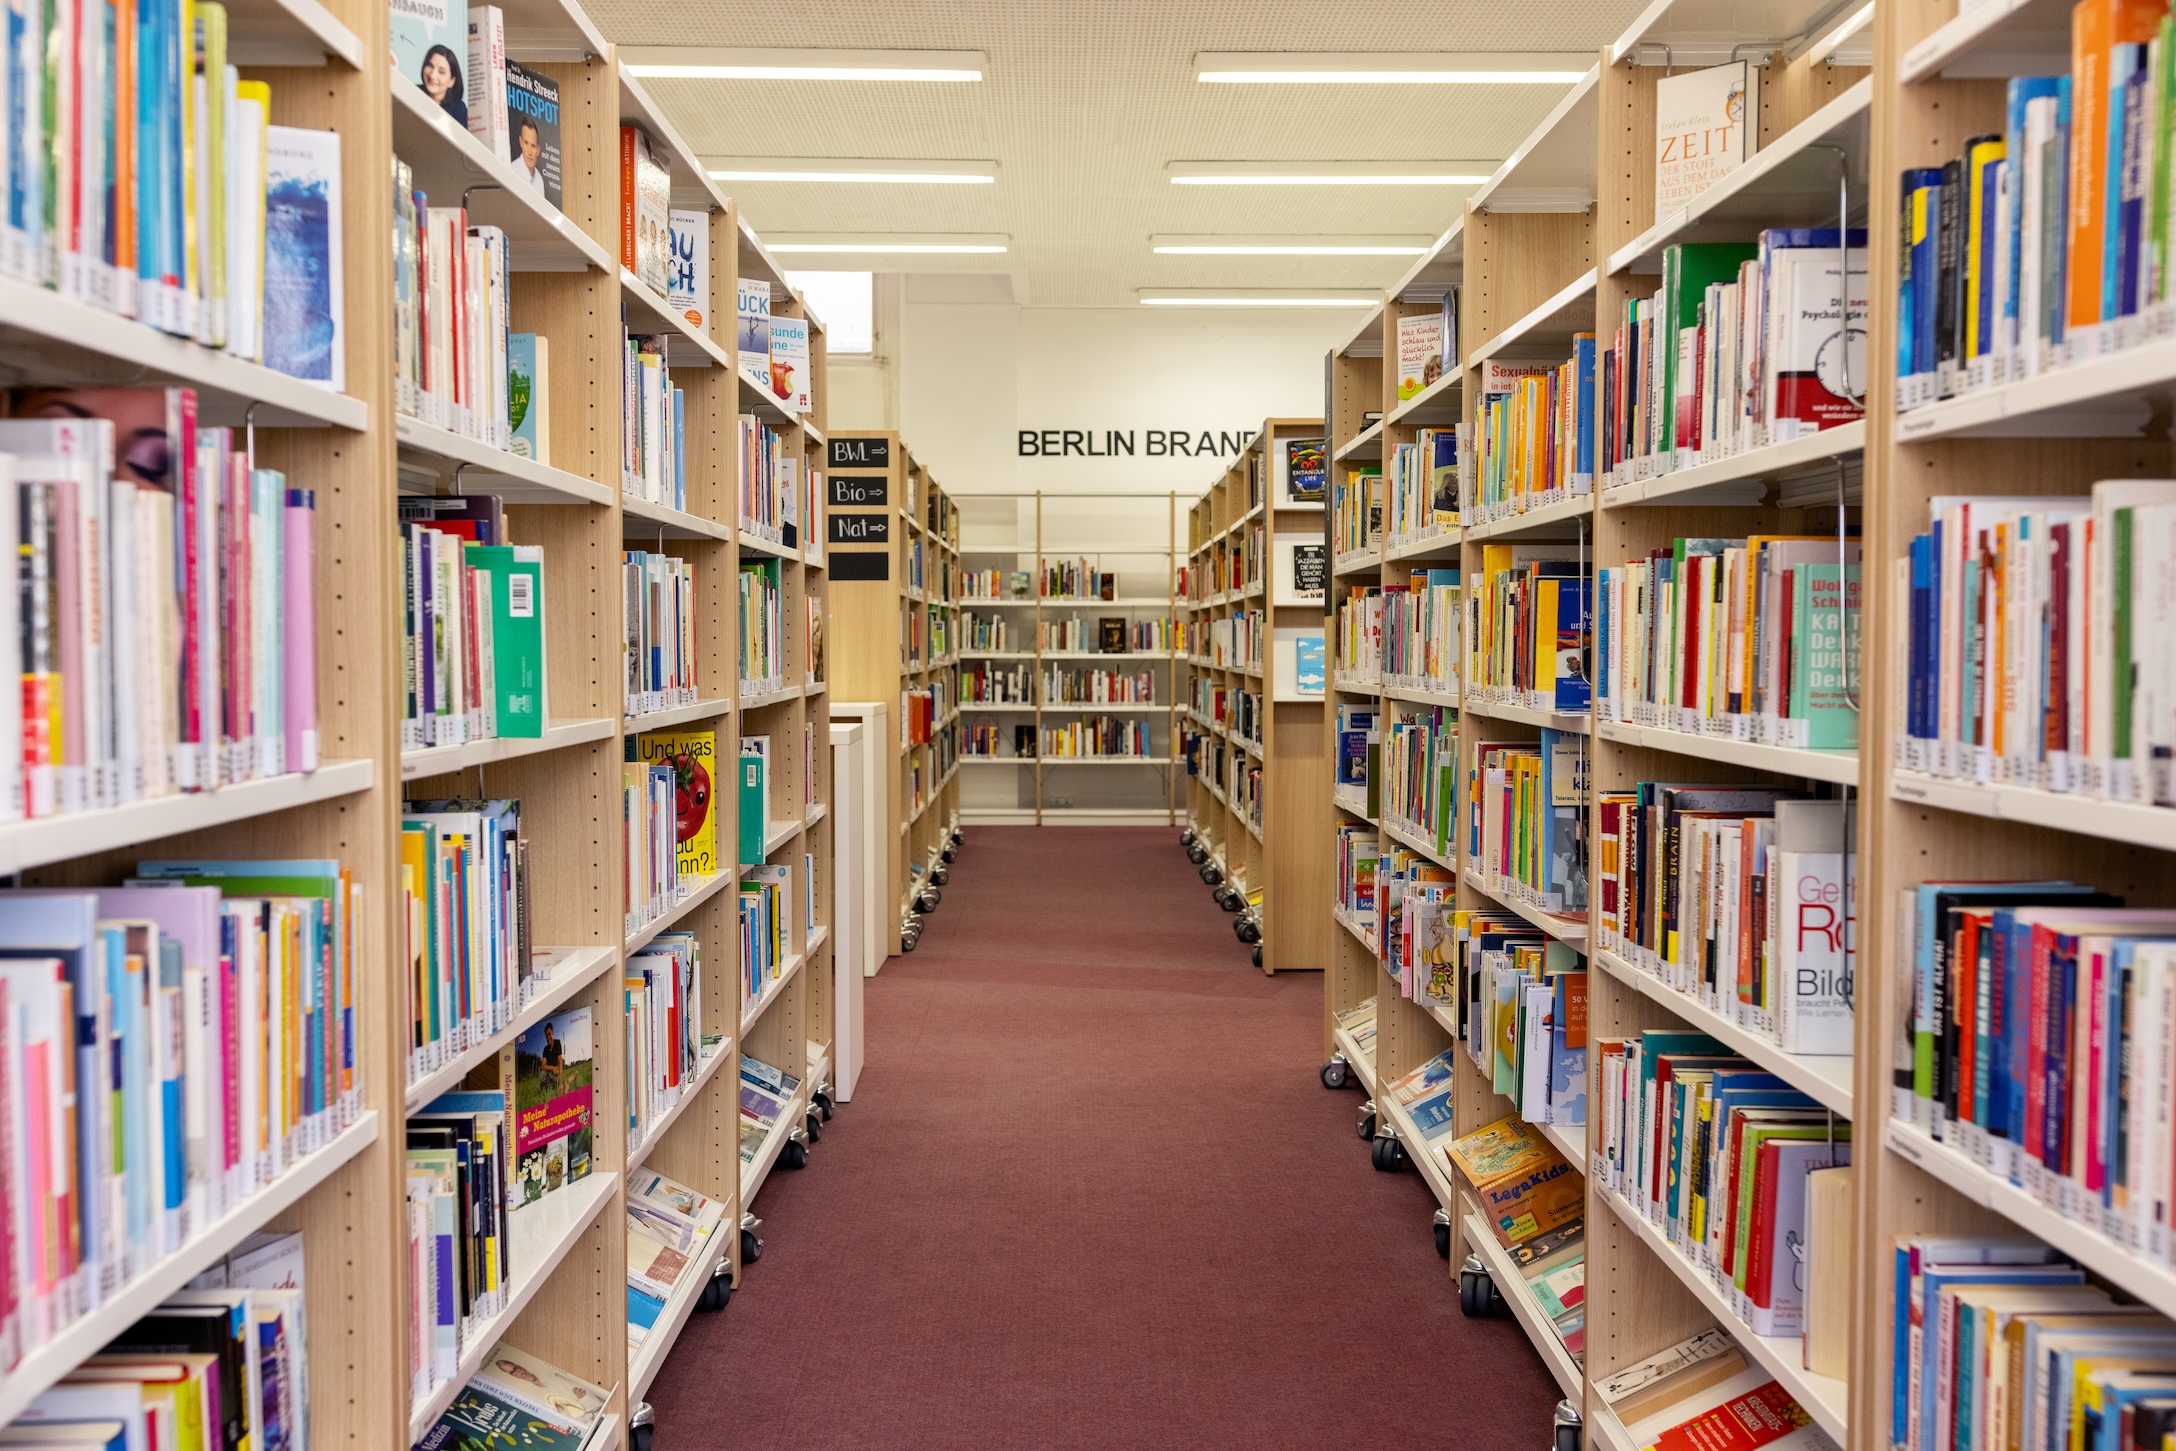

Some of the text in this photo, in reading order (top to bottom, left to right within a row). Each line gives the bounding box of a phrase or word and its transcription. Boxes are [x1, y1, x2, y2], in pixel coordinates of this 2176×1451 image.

[506, 68, 559, 102] Hendrik Streeck
[506, 84, 559, 126] HOTSPOT
[1689, 116, 1710, 126] Klein
[1660, 125, 1734, 164] ZEIT
[1661, 158, 1716, 176] DER STOFF
[1660, 167, 1733, 188] AUS DEM DAS
[1660, 187, 1692, 200] LEBEN
[770, 327, 804, 340] sunde
[1402, 334, 1441, 346] schlau und
[1416, 325, 1439, 335] Kinder
[1402, 344, 1434, 356] glücklich
[1402, 353, 1424, 362] macht!
[834, 442, 870, 462] BWL
[1018, 430, 1134, 456] BERLIN
[836, 480, 866, 502] Bio
[838, 518, 868, 538] Nat
[1436, 514, 1451, 522] Das
[1583, 611, 1592, 620] Au
[642, 738, 675, 760] Und
[680, 741, 712, 757] was
[1670, 826, 1679, 876] BRAIN
[680, 852, 709, 874] nn?
[1933, 939, 1945, 1036] DAS IST ALPHA!
[504, 1074, 513, 1167] Meine Naturapotheke
[522, 1108, 547, 1124] Meine
[533, 1104, 585, 1132] Naturapotheke
[1516, 1218, 1533, 1228] Kinder
[1519, 1223, 1535, 1233] Zukunft
[484, 1382, 539, 1413] TREFFEN SICH ZWEI
[446, 1403, 499, 1433] Krebs
